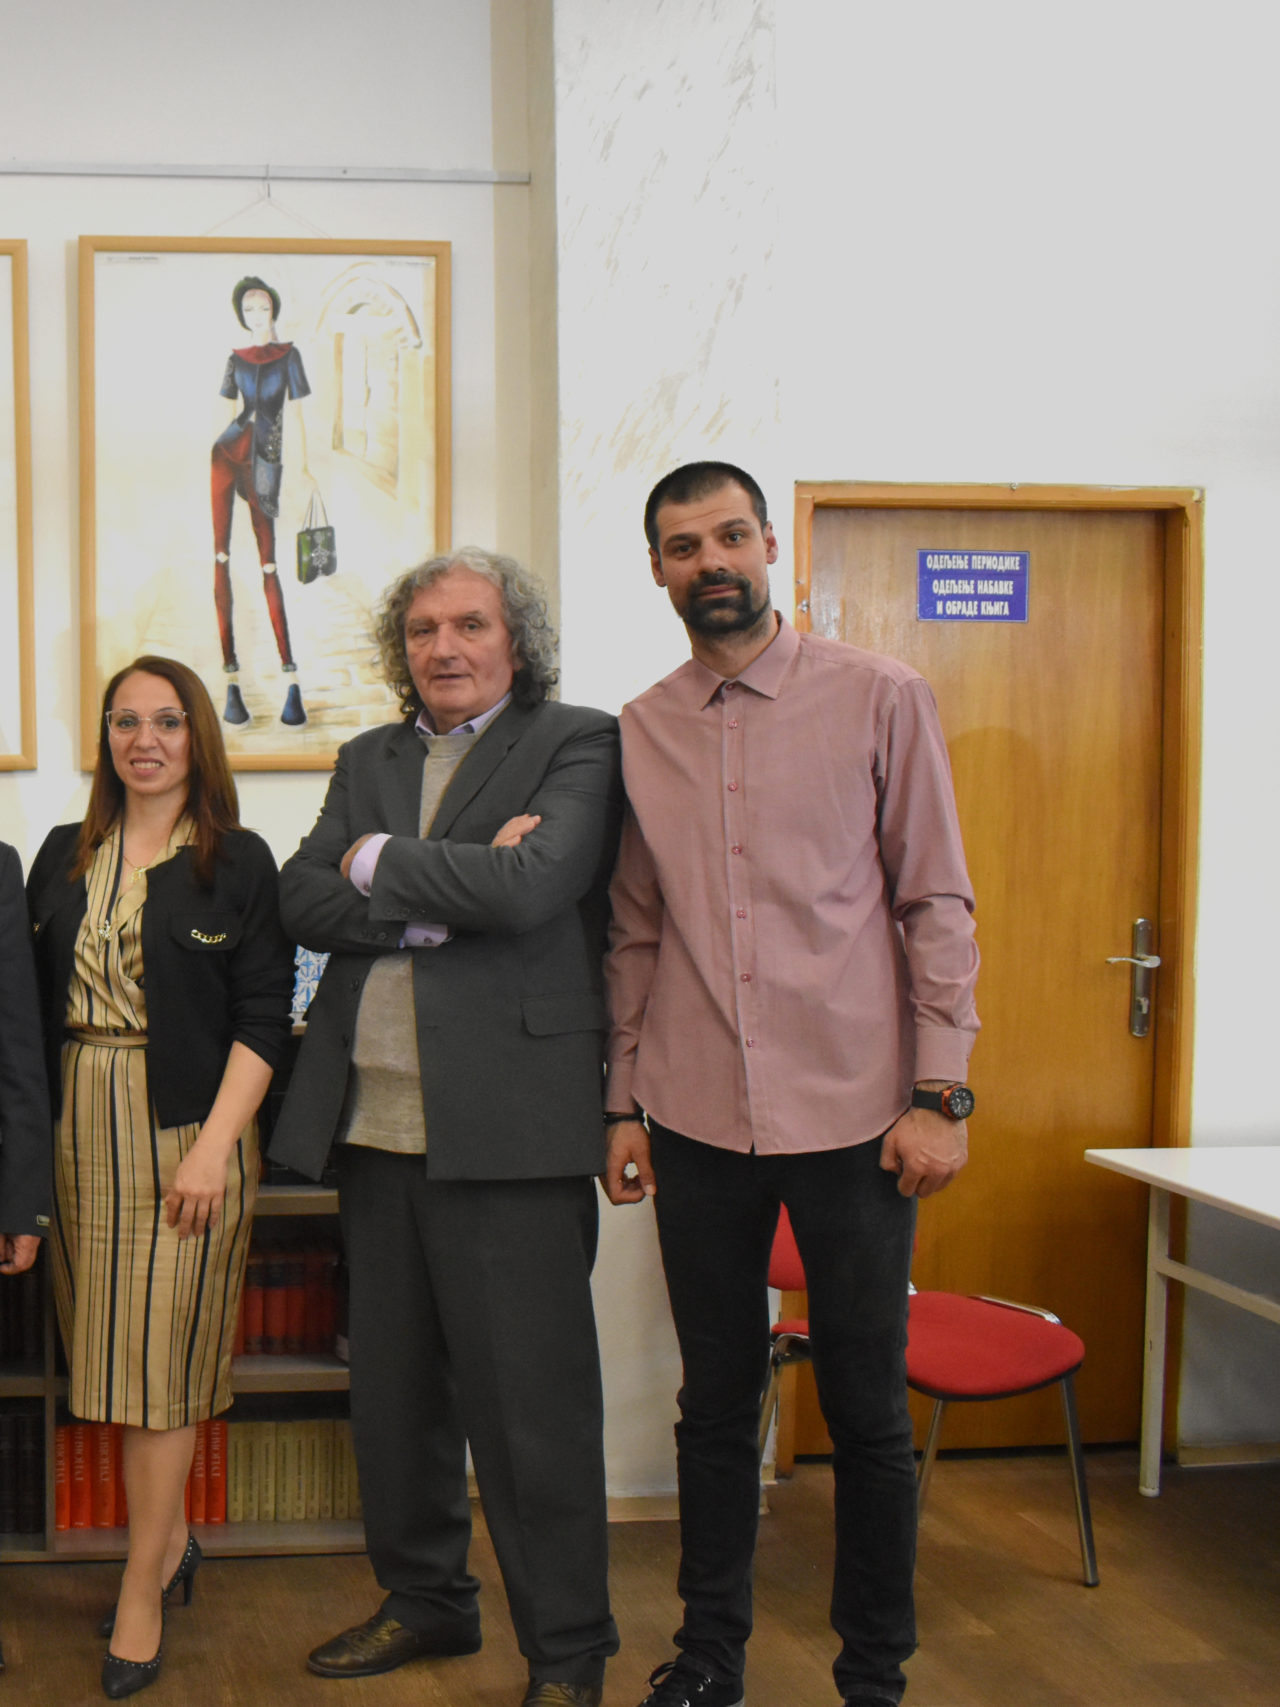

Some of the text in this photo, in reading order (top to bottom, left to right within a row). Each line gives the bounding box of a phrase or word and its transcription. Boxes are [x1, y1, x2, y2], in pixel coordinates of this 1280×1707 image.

[926, 555, 1020, 572] ОДЕЉЕЊЕ ПЕРИОДИКЕ
[932, 579, 1014, 596] ОДЕЉЕЊЕ НАБАВКЕ
[936, 600, 1009, 617] И ОБРАДЕ КЊИГА
